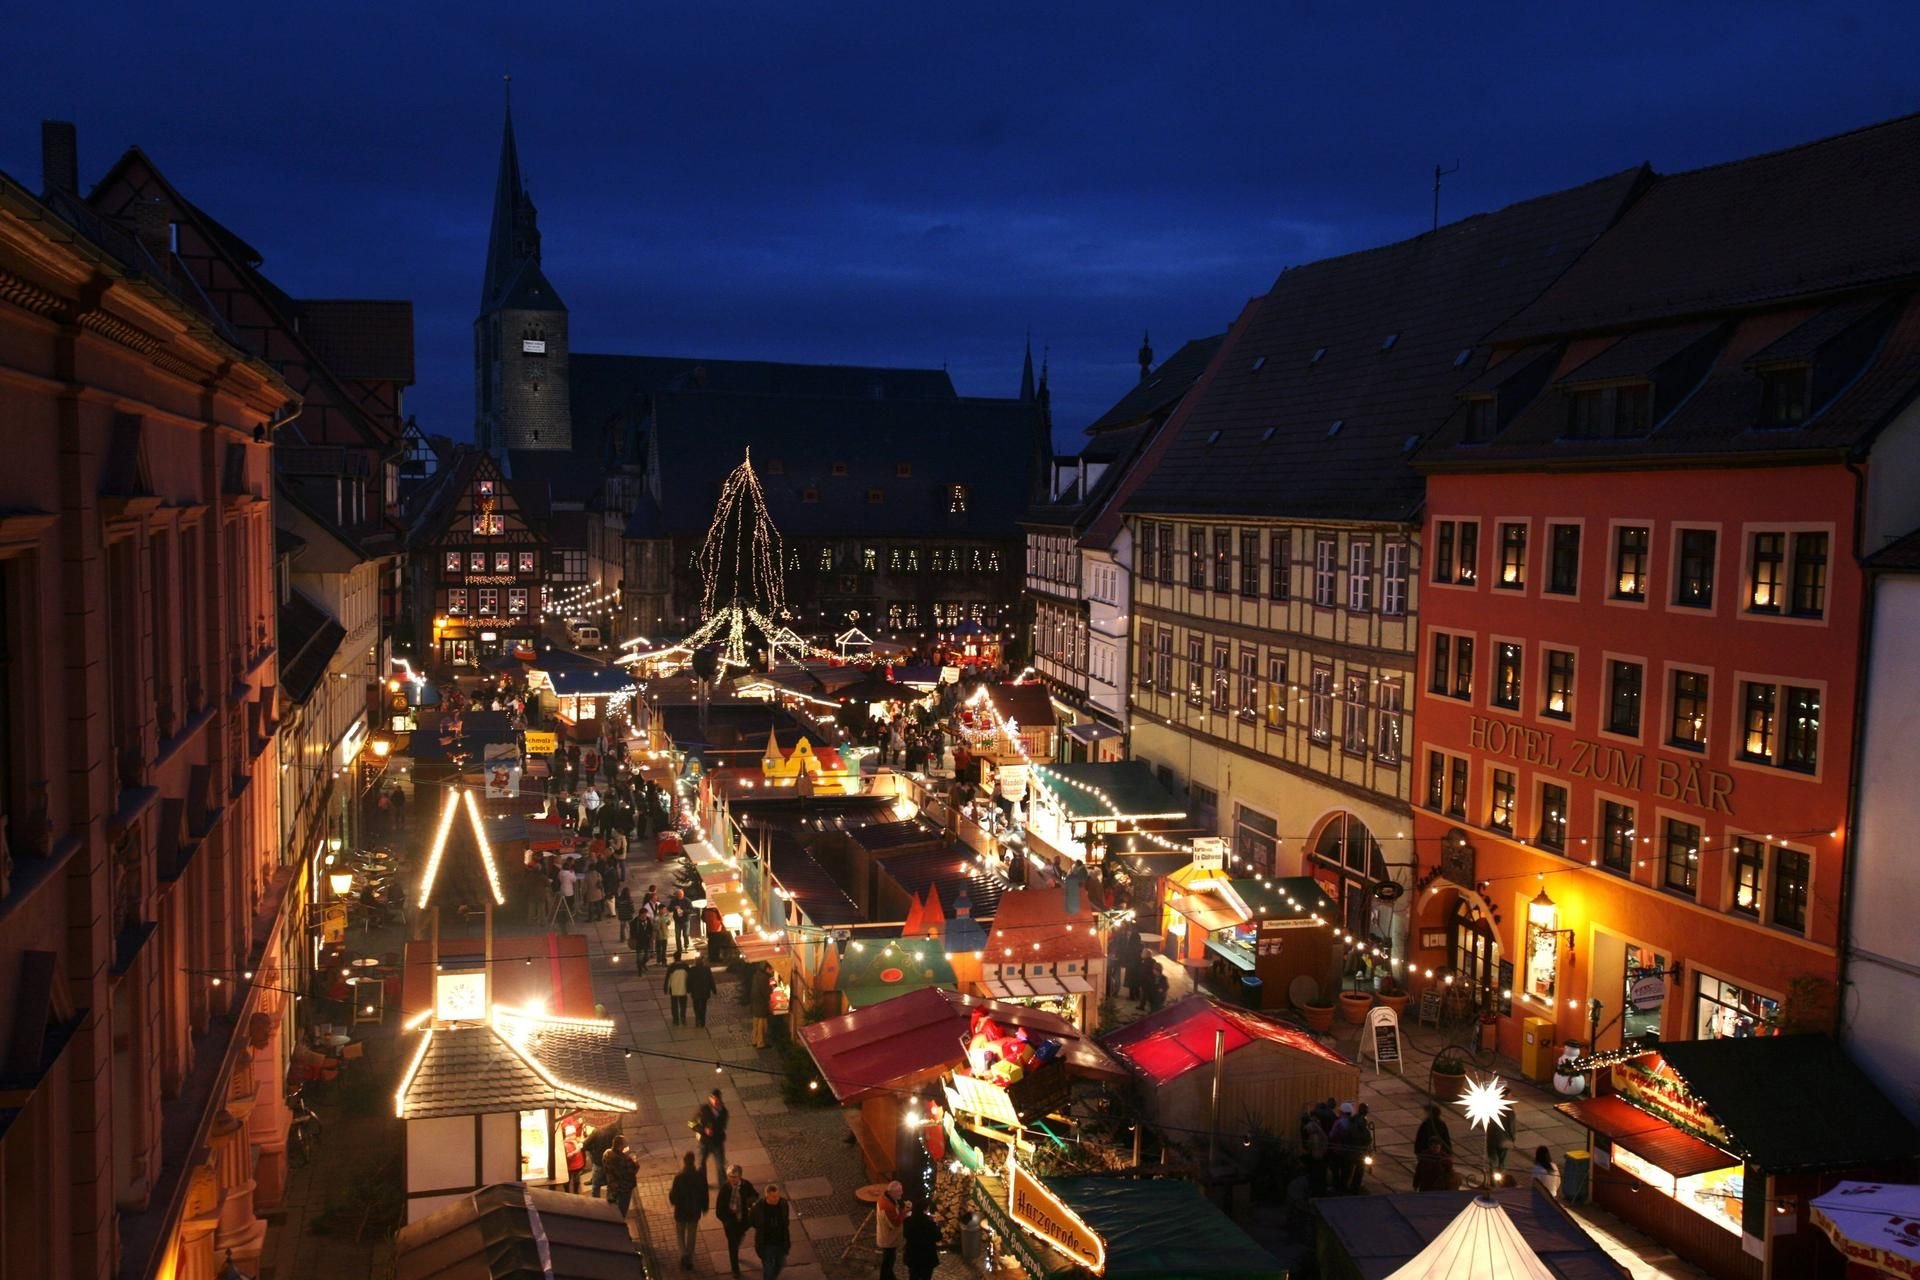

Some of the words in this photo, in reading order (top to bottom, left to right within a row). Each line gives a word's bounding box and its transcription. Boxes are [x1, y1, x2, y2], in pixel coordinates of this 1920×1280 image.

[1468, 715, 1562, 769] HOTEL
[1568, 740, 1646, 792] ZUM
[1653, 758, 1735, 816] BÄR
[1018, 1190, 1080, 1250] Harzgerode
